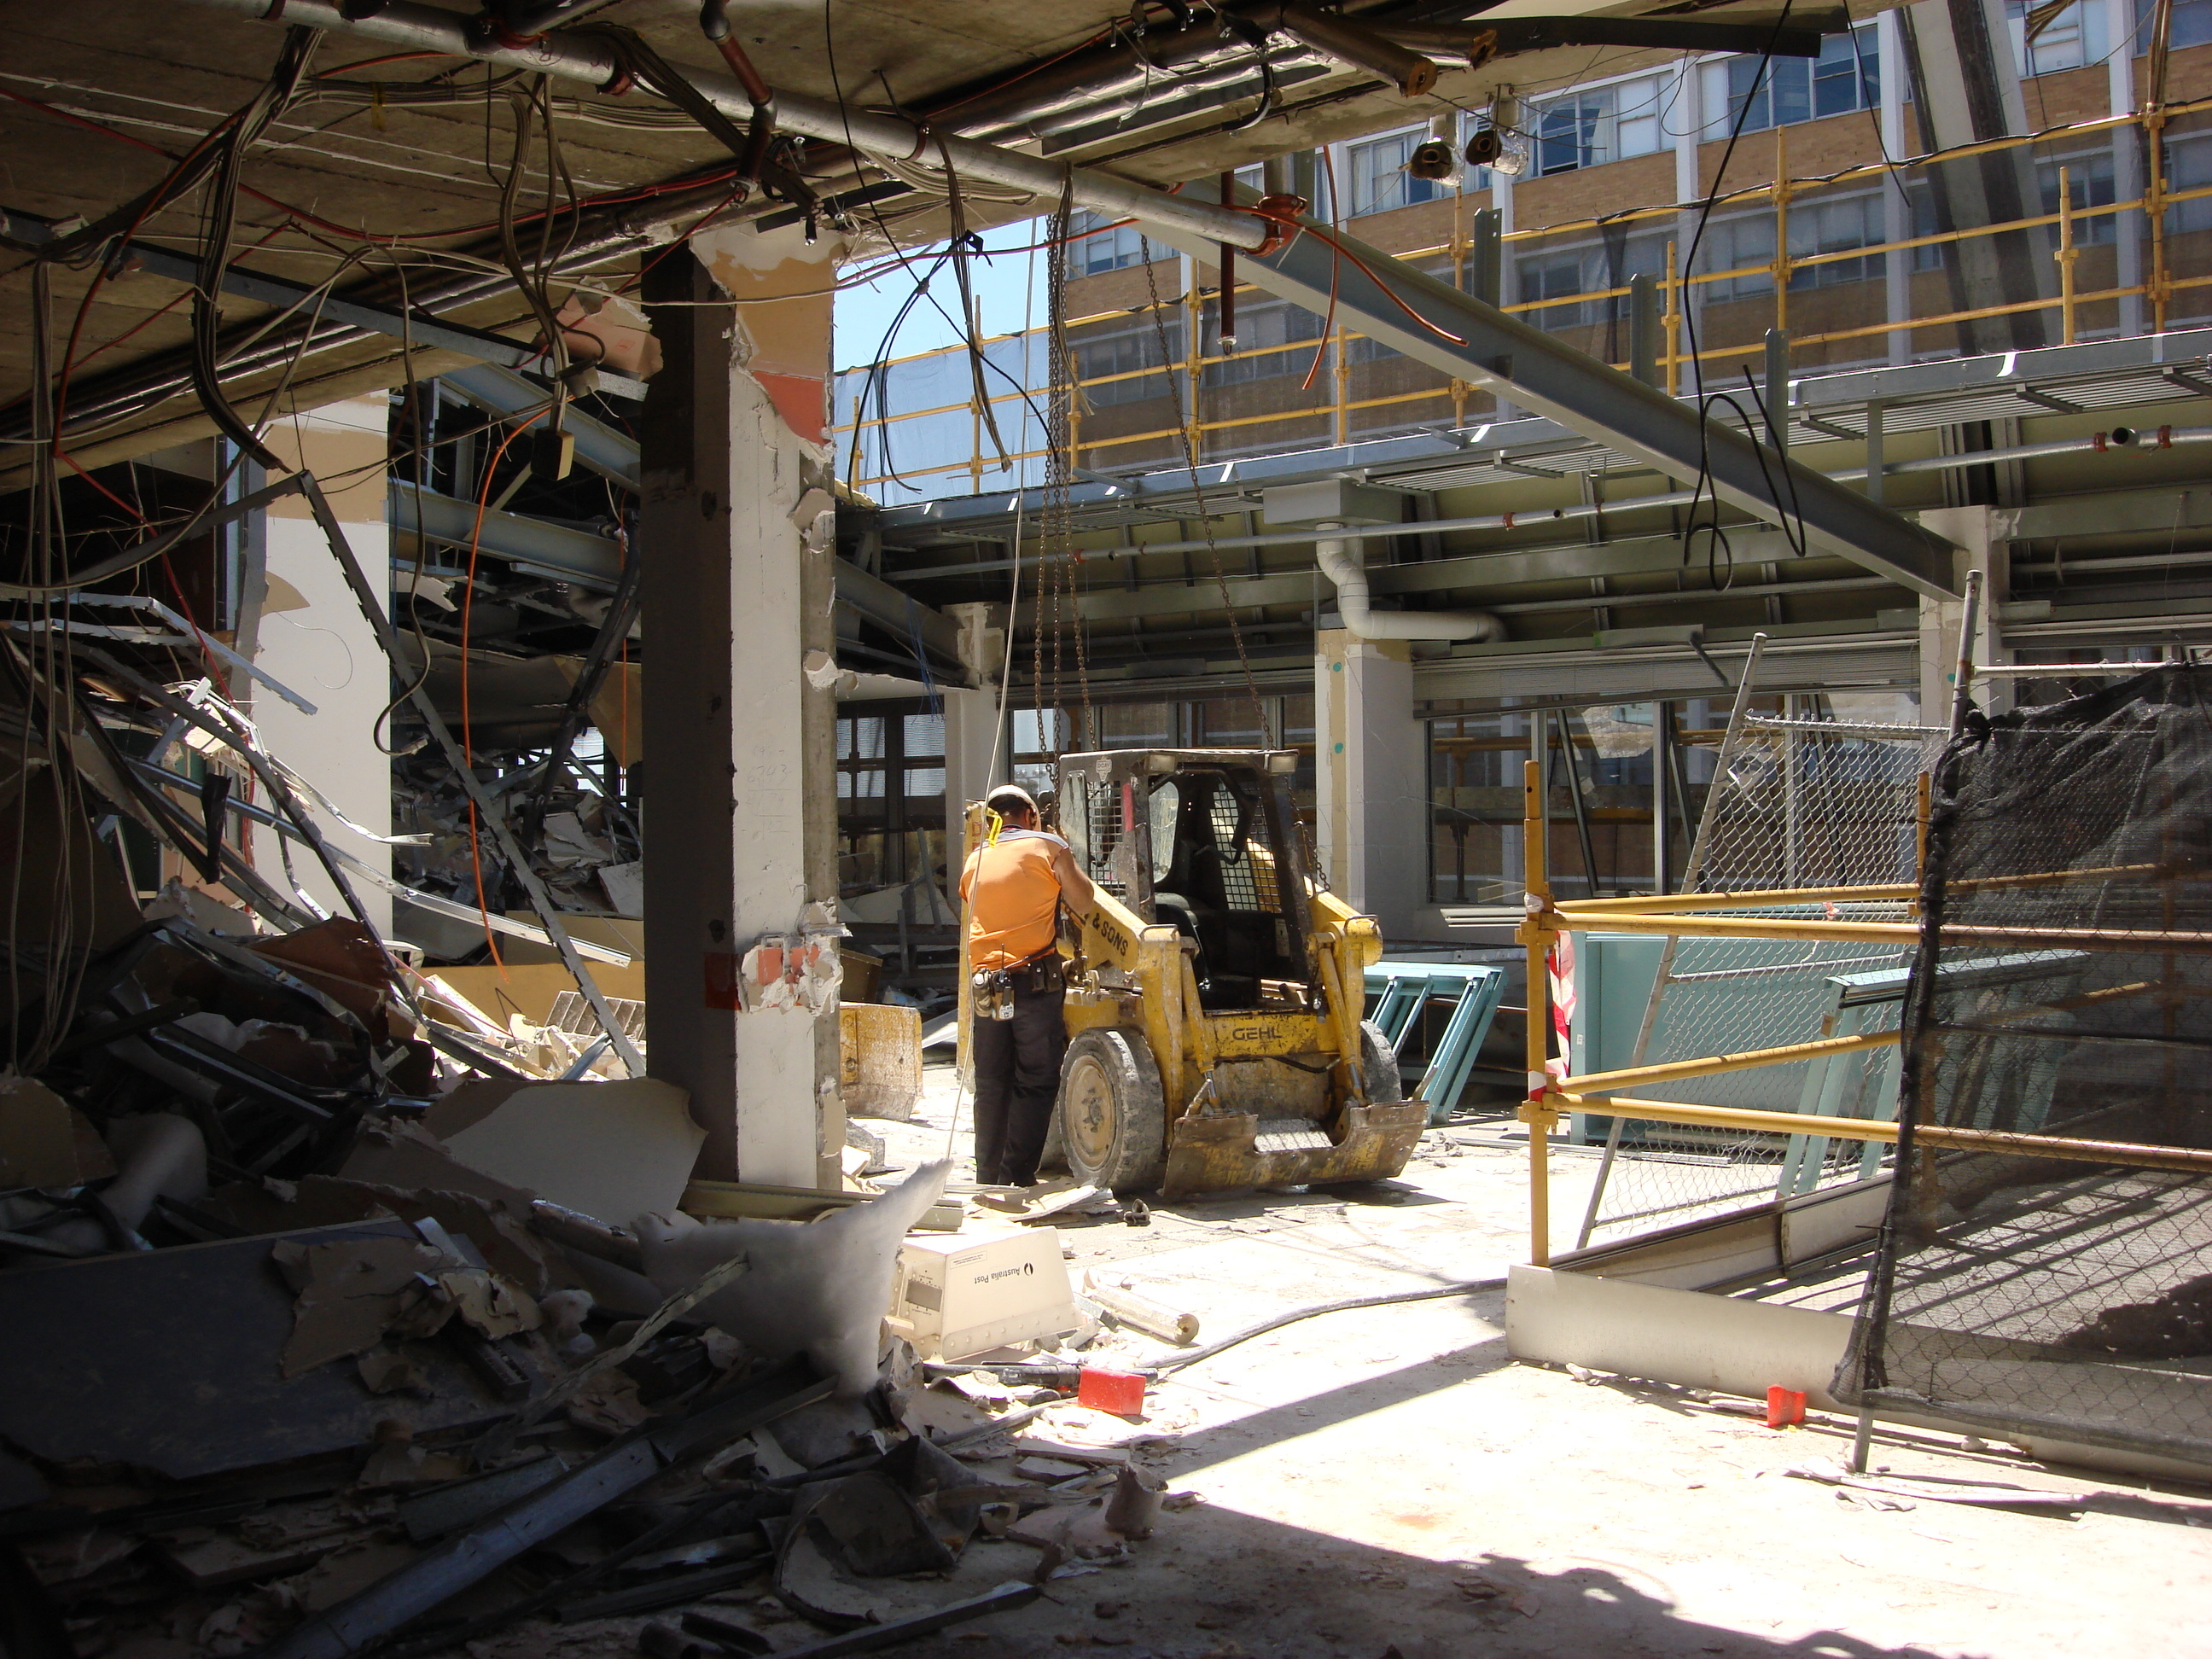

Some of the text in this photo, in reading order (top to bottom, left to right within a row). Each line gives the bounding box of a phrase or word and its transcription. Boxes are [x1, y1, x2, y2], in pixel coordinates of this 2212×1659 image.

[1101, 921, 1128, 956] SONS
[1232, 1027, 1283, 1040] GEHL
[974, 1267, 1021, 1284] Australia Post
